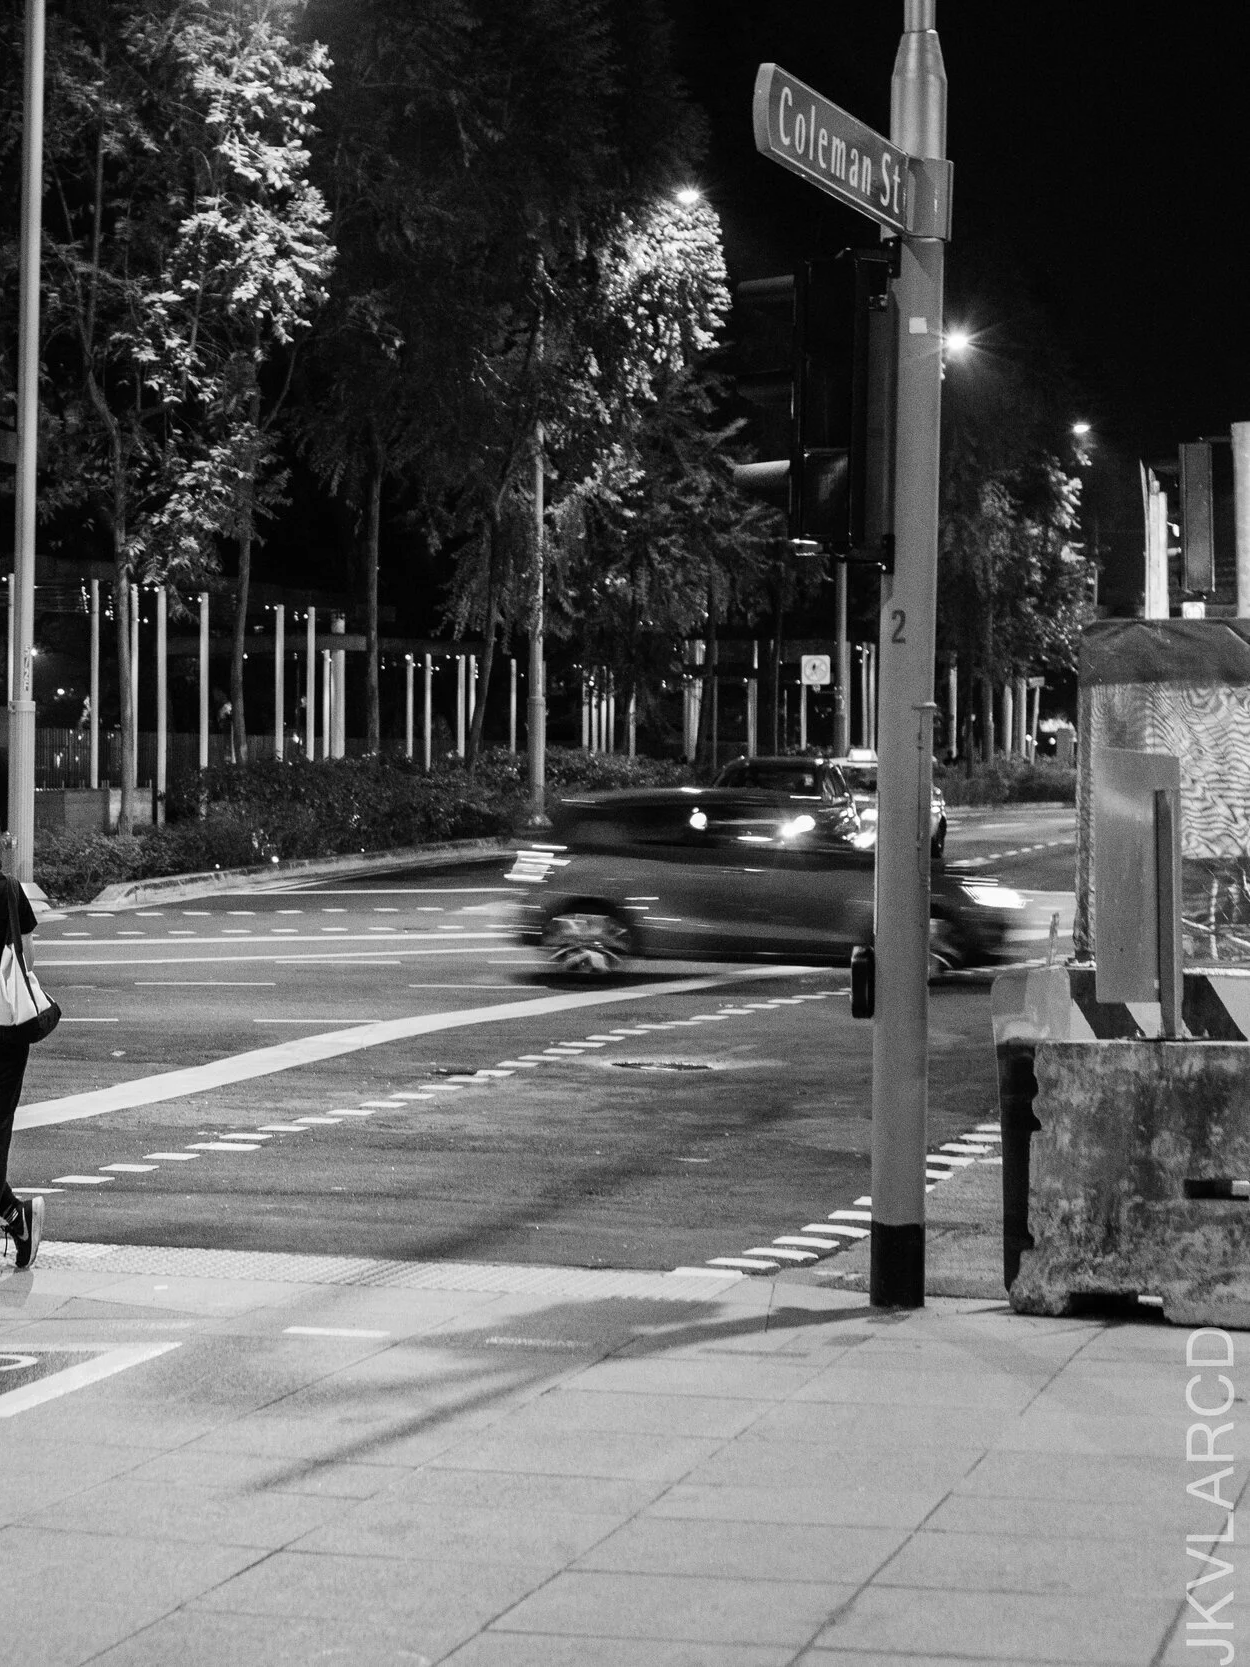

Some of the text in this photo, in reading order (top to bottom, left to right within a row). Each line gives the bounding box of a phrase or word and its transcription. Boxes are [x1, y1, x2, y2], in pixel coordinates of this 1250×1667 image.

[779, 86, 901, 214] Coleman St
[891, 610, 906, 644] 2
